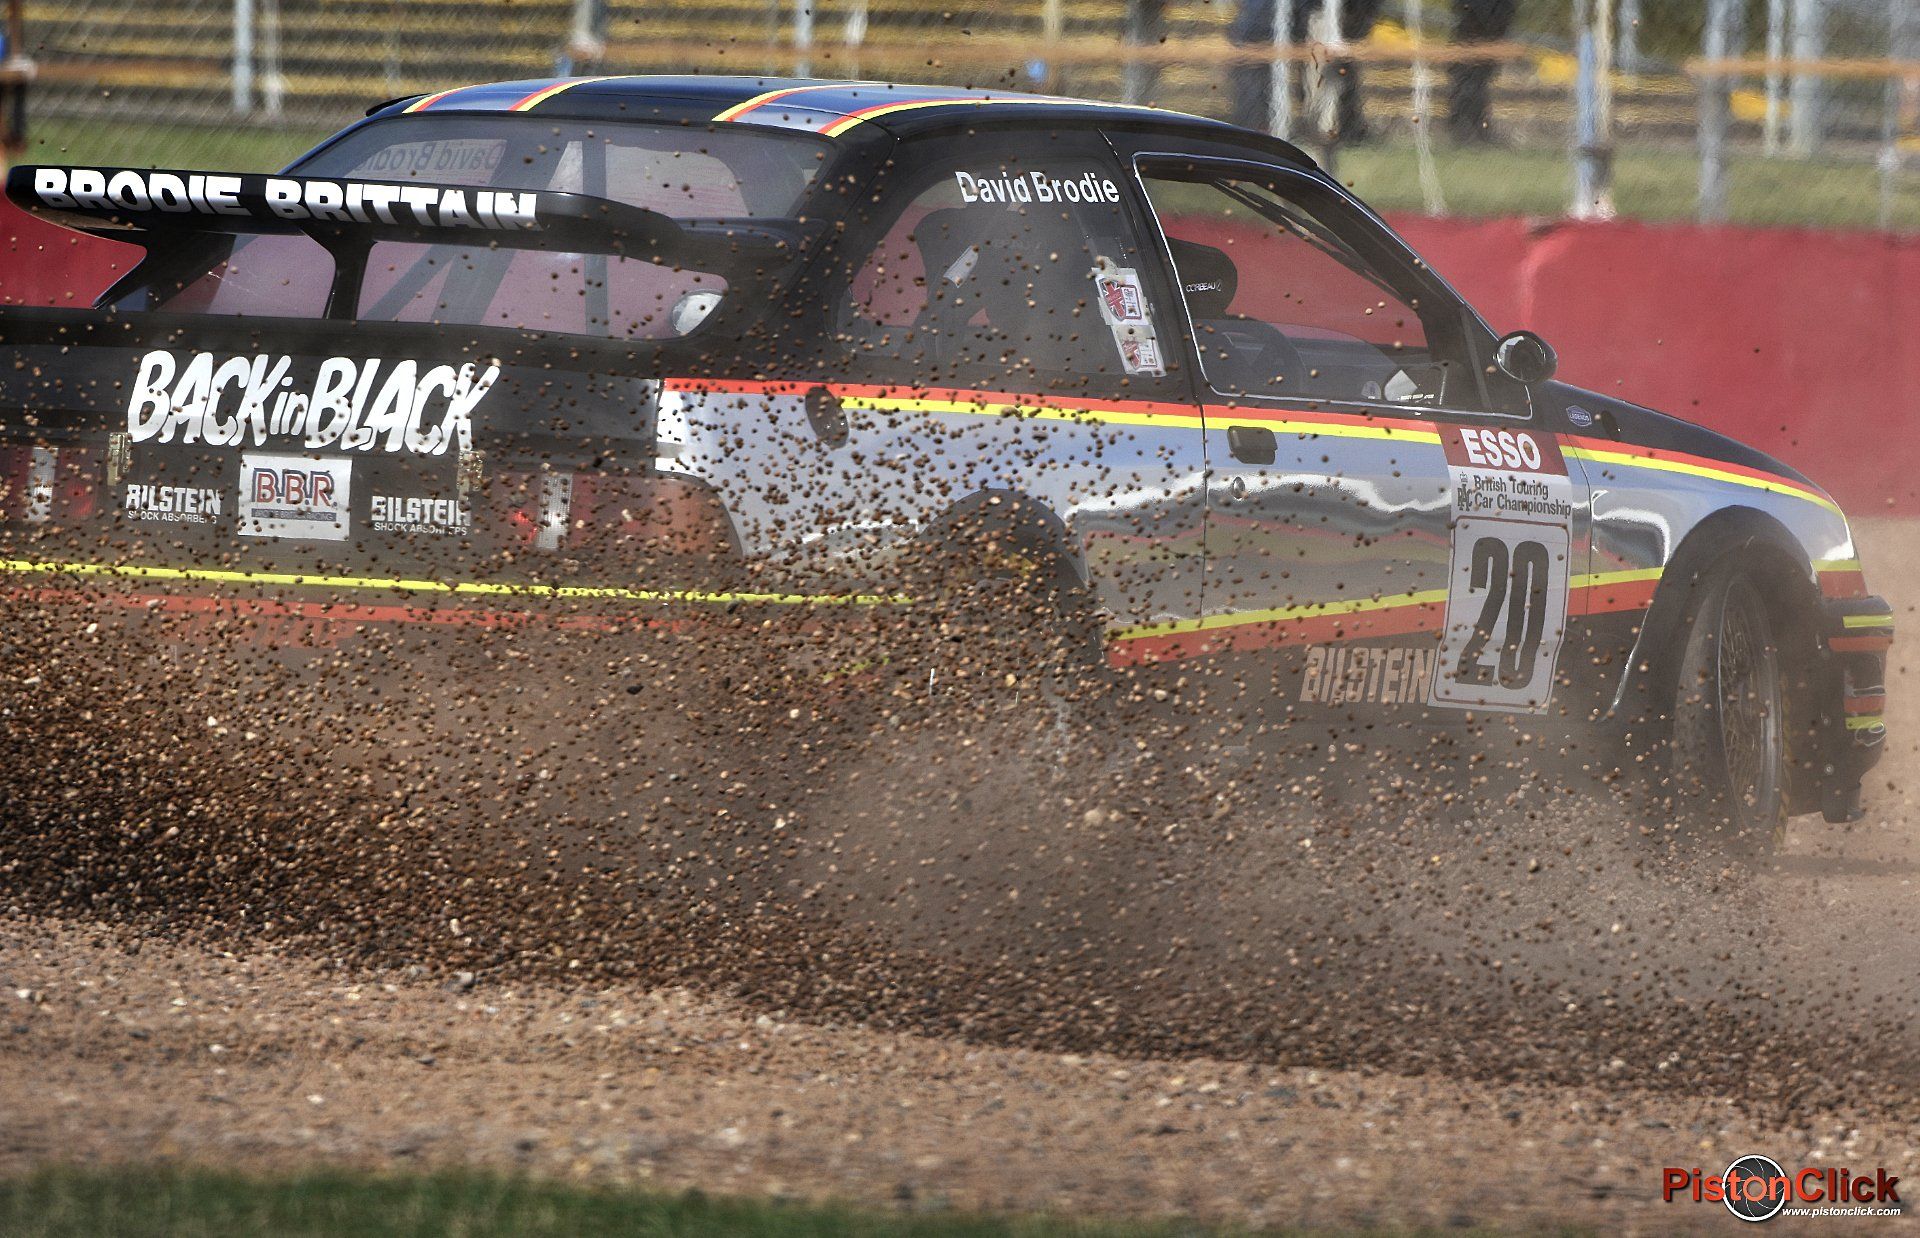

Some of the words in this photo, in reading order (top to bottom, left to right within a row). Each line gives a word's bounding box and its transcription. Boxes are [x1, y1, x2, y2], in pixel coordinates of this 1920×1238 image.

[35, 168, 252, 215] BRODIE
[265, 178, 545, 231] BRITTAIN
[955, 171, 1032, 203] David
[1030, 171, 1120, 203] Brodie
[1186, 282, 1216, 292] CORBEAU
[127, 350, 292, 446] BACK
[270, 376, 308, 435] in
[304, 357, 500, 455] BLACK
[1460, 427, 1541, 470] ESSO
[125, 484, 221, 515] BILSTEIN
[1473, 475, 1507, 493] British
[1511, 479, 1549, 500] Touring
[128, 510, 160, 521] SOCK
[161, 512, 217, 525] ABSORBES
[1474, 492, 1494, 510] Car
[1496, 493, 1572, 519] Championship
[374, 521, 408, 532] SHOCK
[409, 524, 468, 536] ABSORS
[1454, 536, 1550, 691] 20
[1299, 646, 1436, 703] BILSTEIN
